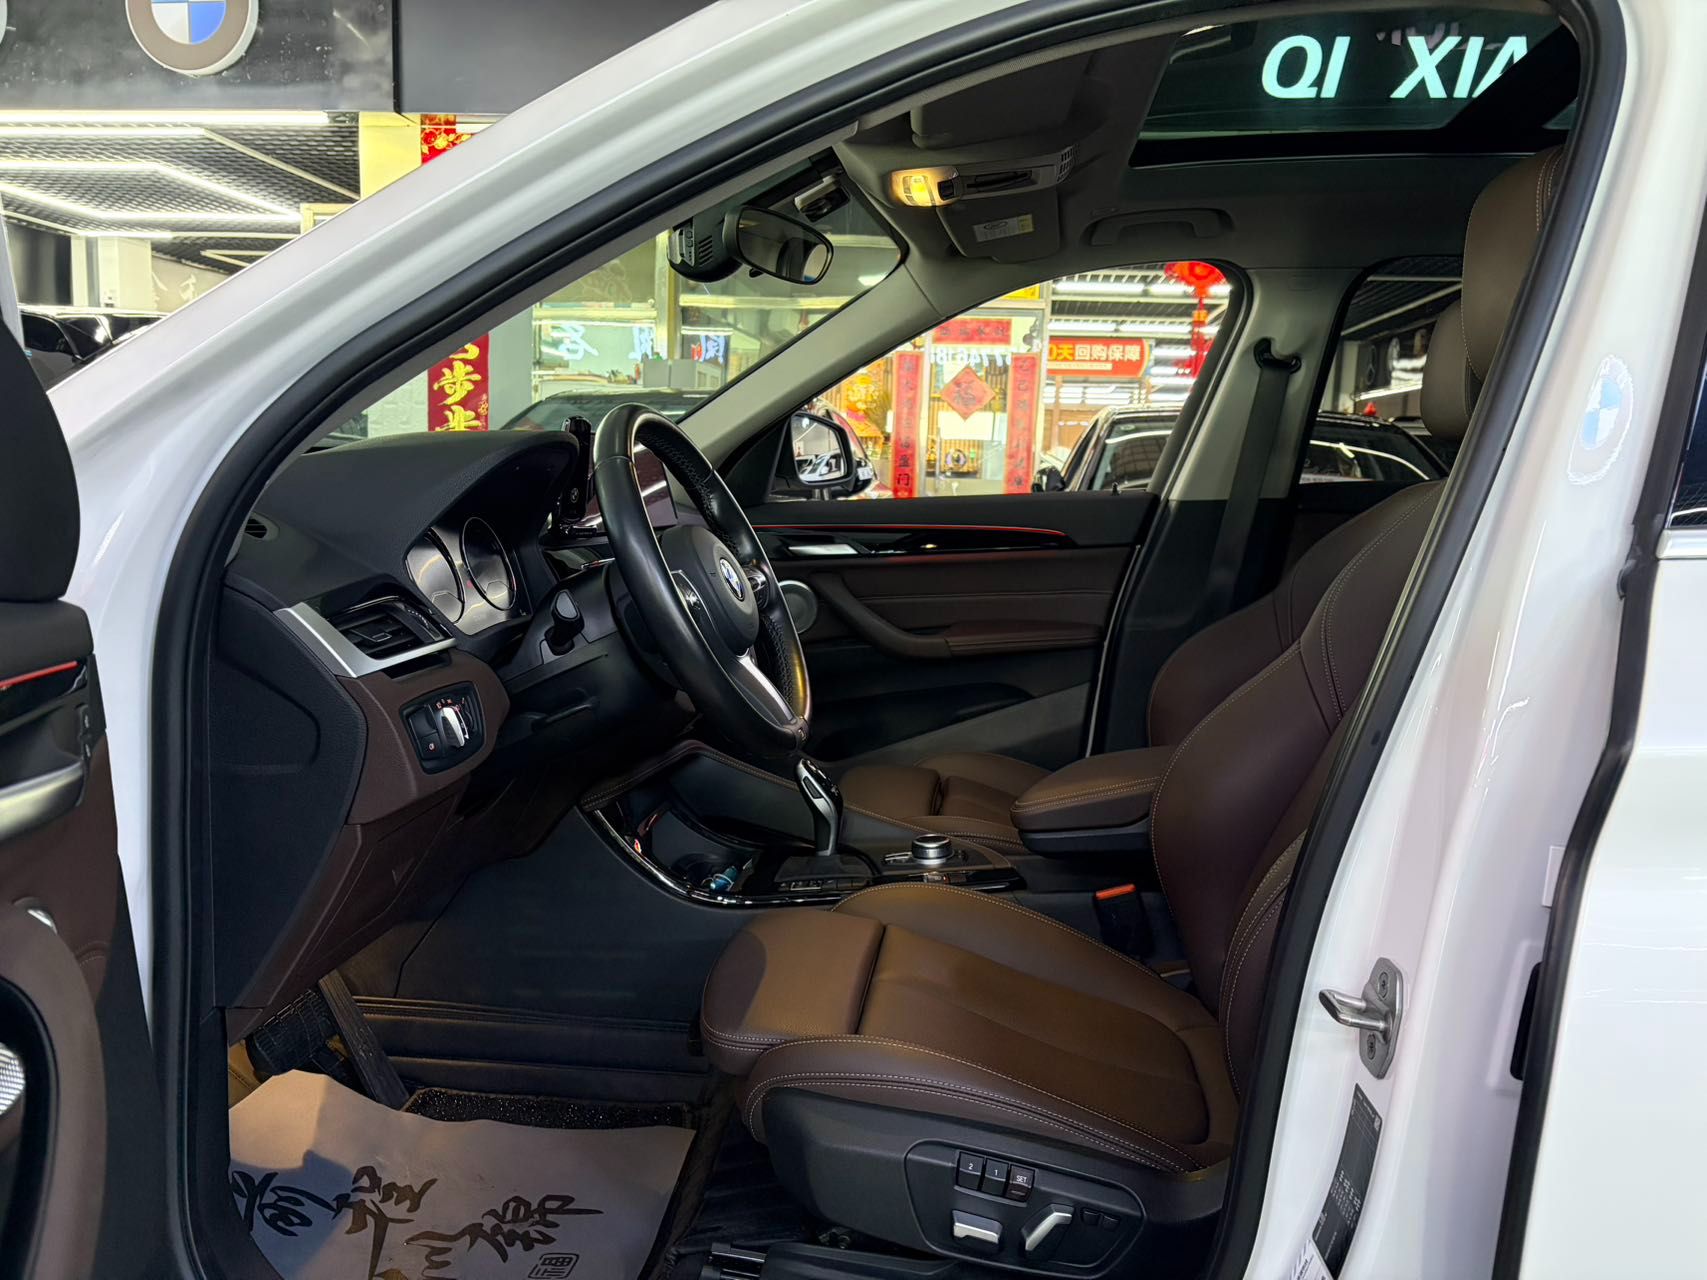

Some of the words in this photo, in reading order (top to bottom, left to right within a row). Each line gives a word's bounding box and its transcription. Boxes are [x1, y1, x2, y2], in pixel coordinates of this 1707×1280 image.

[1261, 35, 1351, 99] QI
[433, 343, 482, 431] 步步
[1016, 1175, 1028, 1183] SET
